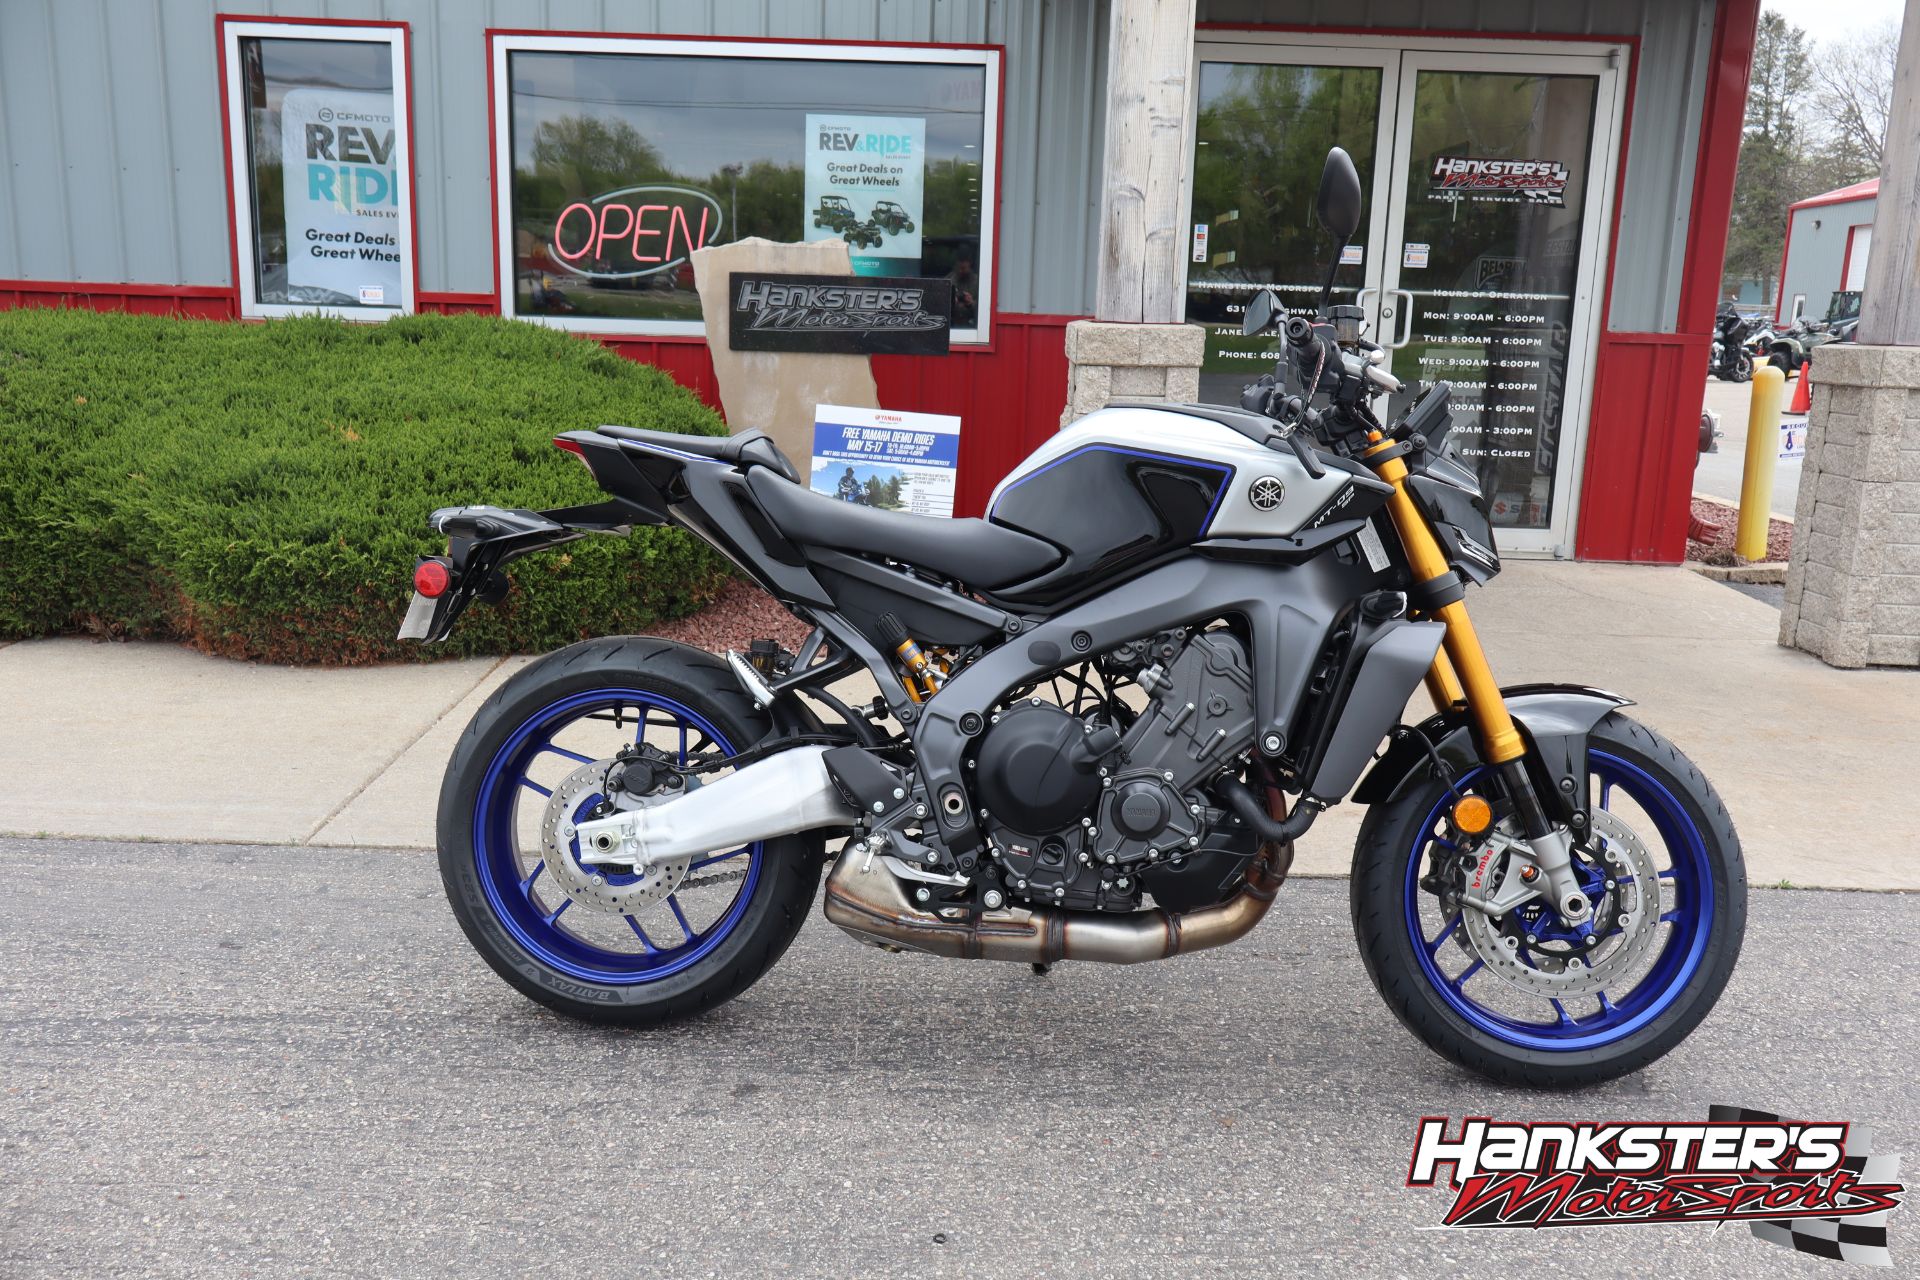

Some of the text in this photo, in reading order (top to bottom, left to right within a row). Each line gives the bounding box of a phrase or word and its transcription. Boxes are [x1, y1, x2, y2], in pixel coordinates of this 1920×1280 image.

[337, 112, 390, 123] CFMOTO
[827, 162, 903, 175] Great Deals on
[830, 175, 900, 187] Great Wheels
[356, 209, 399, 219] SALES EV
[305, 228, 395, 246] Great Deals
[554, 202, 708, 262] OPEN
[311, 245, 356, 259] Great
[1198, 282, 1340, 294] HANKSTER'S MOTORSPOS
[1433, 289, 1469, 298] HOURS
[1489, 291, 1548, 301] OPERATION
[1423, 311, 1450, 320] MON:
[1453, 313, 1494, 322] 9:00AM
[1504, 315, 1545, 324] 6:00PM
[1423, 335, 1447, 343] TUE:
[1451, 336, 1492, 344] 9:00AM
[1502, 338, 1542, 346] 6:00PM
[1218, 350, 1257, 359] PHONE:
[1418, 357, 1445, 365] WED:
[1449, 358, 1489, 367] 9:00AM
[1500, 360, 1540, 369] 6:00PM
[1497, 382, 1537, 391] 6:00PM
[1448, 403, 1484, 412] :00AM
[1495, 405, 1535, 413] 6:00PM
[880, 415, 902, 423] YAMAHA
[842, 427, 935, 446] FREE YAMAHA DEMO RIDES
[1493, 427, 1533, 436] 3:00PM
[847, 439, 865, 451] MAY
[864, 441, 882, 453] 15-17
[1462, 448, 1531, 458] SUN: CLOSED
[1314, 485, 1355, 529] MT-09
[1341, 493, 1355, 509] SP
[1471, 849, 1493, 889] brembo
